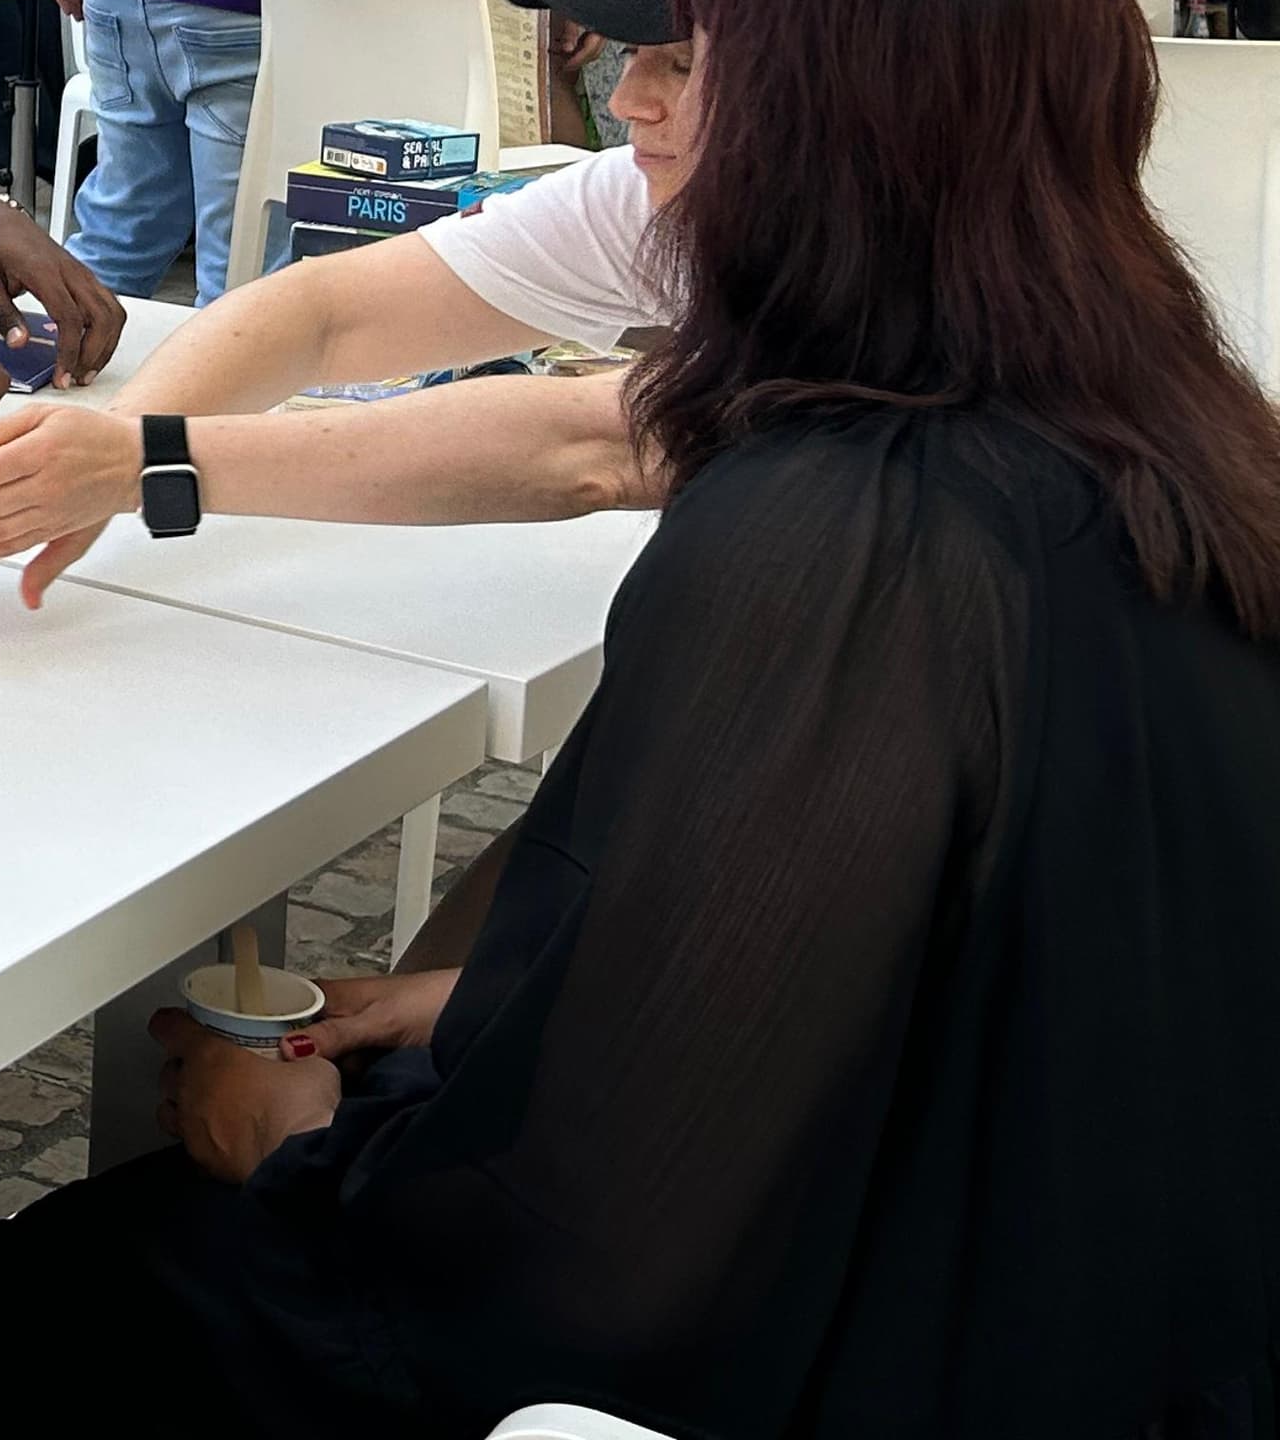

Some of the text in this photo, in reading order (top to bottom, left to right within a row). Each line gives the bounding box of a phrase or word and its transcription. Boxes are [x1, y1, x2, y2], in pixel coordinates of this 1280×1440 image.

[403, 141, 422, 154] SEA
[402, 155, 411, 169] &
[348, 196, 406, 223] PARIS
